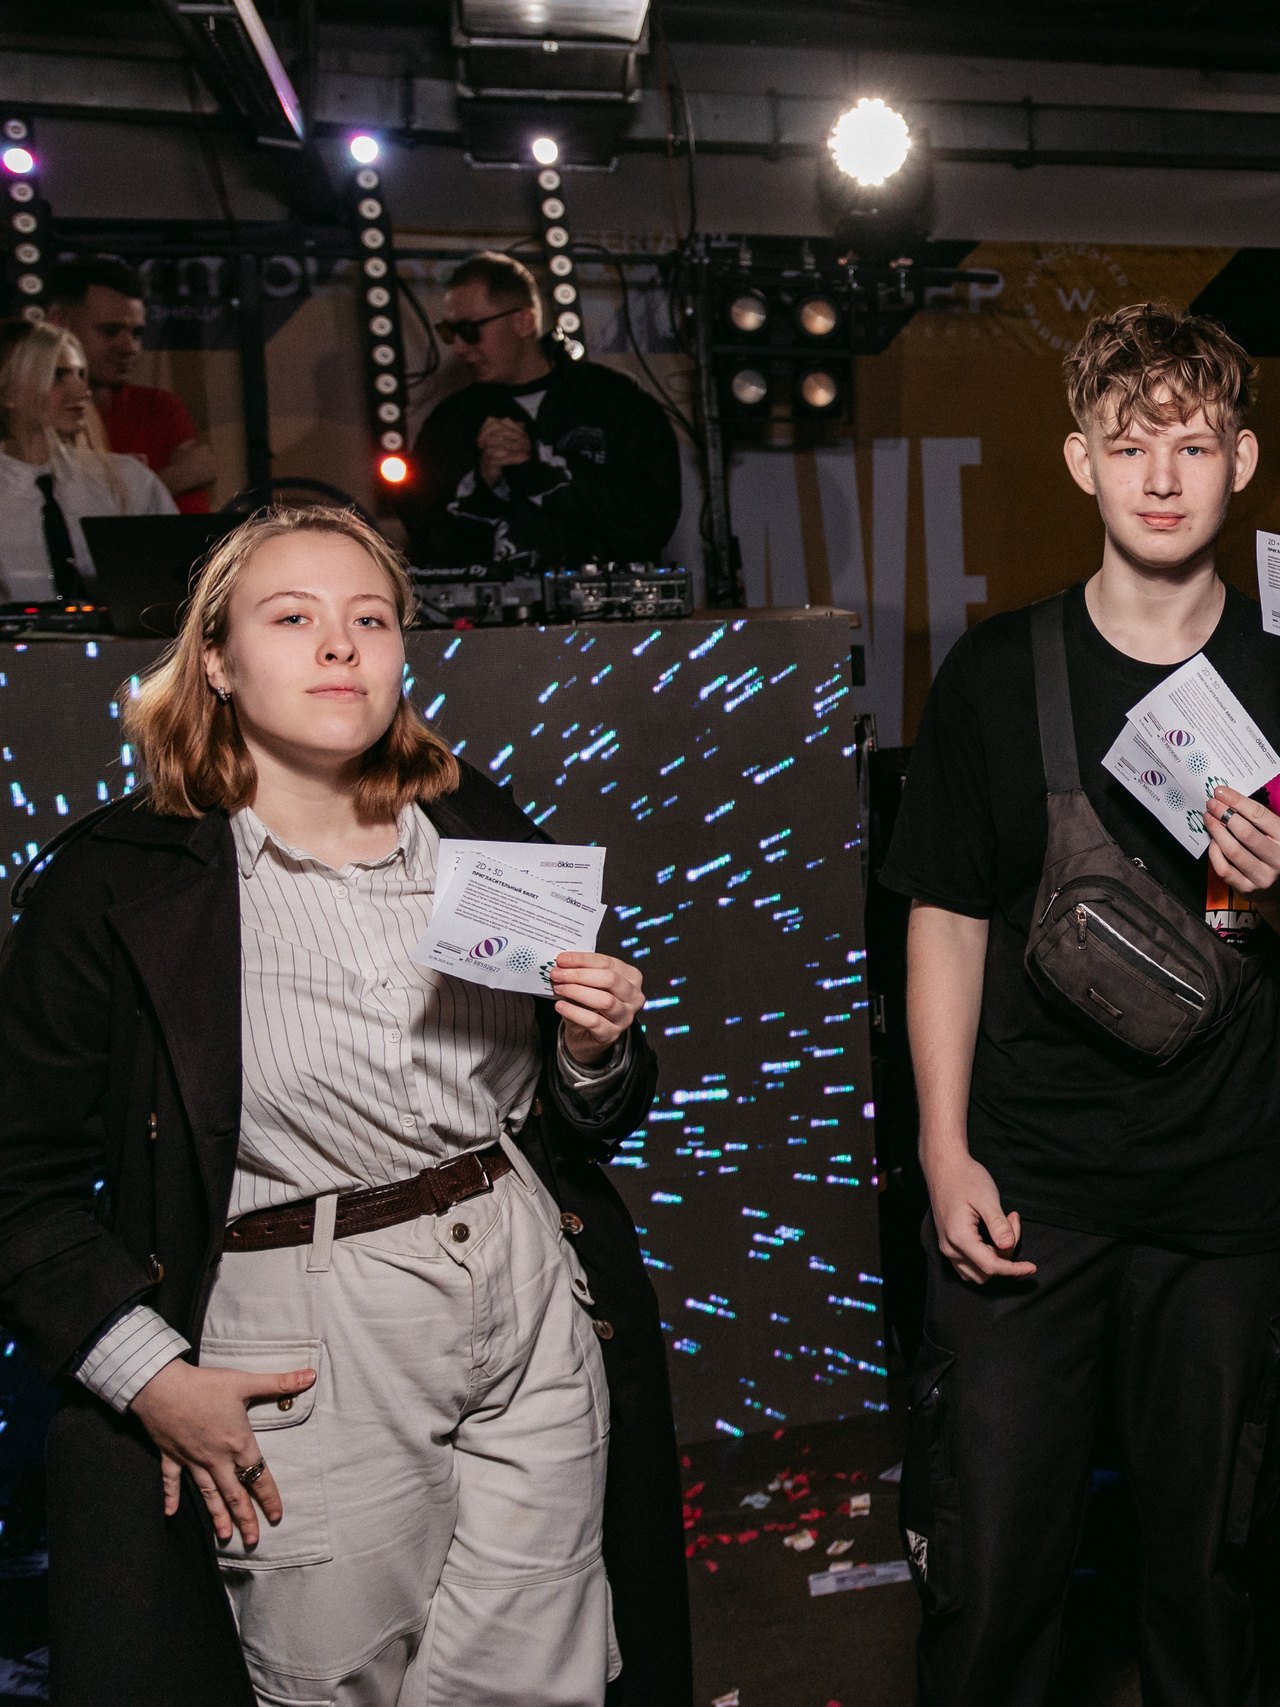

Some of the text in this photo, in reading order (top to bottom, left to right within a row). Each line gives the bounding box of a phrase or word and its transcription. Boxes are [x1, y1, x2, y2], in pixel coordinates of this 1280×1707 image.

[1056, 286, 1096, 312] W
[1201, 667, 1210, 677] 2D
[1211, 680, 1219, 689] 3D
[476, 861, 486, 870] 2D
[493, 868, 503, 876] 3D
[471, 870, 522, 893] ПРИГЛАСИТЕЛЬНЫЙ
[522, 890, 538, 899] БИЛЕТ
